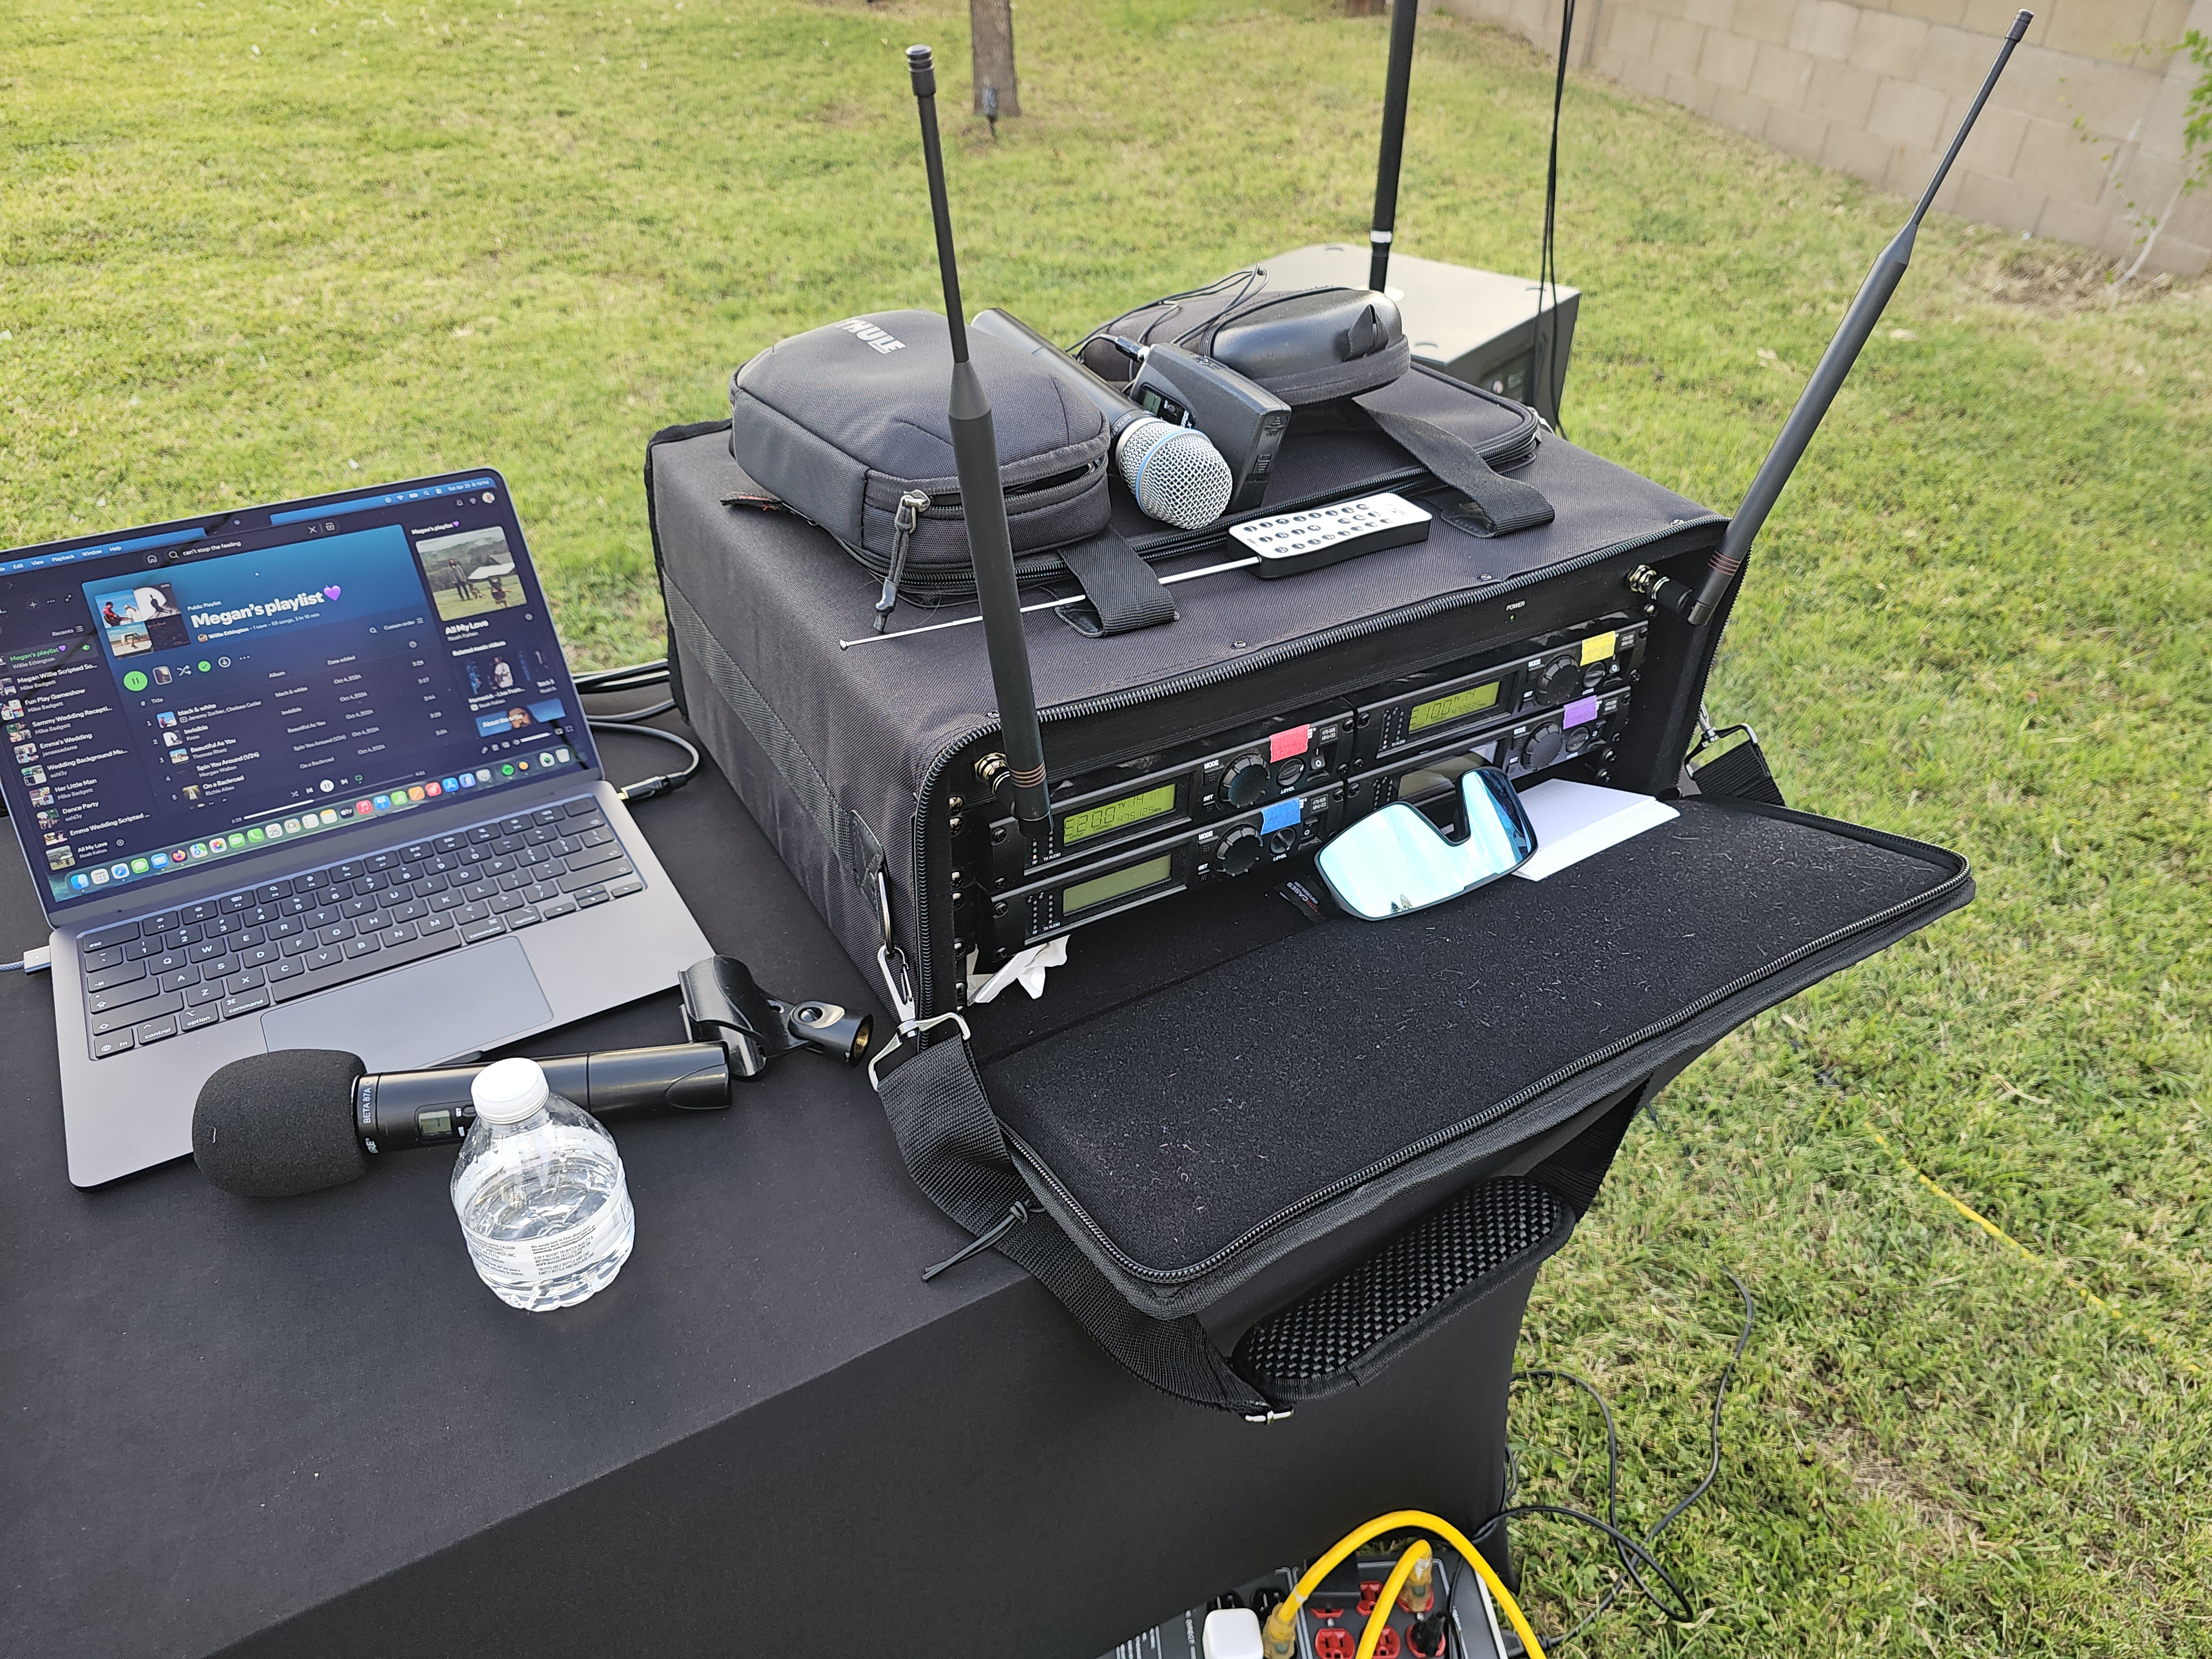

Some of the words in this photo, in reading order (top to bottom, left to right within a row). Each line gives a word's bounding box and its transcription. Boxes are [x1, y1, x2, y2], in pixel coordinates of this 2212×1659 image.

[834, 319, 906, 354] THULE
[221, 541, 242, 550] feeling
[82, 549, 102, 557] Window
[51, 554, 75, 563] Playback
[264, 591, 325, 617] playlist
[1506, 601, 1525, 611] POWER
[445, 626, 457, 635] All
[457, 623, 470, 633] My
[469, 619, 489, 630] Love
[51, 628, 74, 637] Recents
[37, 647, 60, 658] playlist
[29, 656, 56, 667] Ethington
[17, 673, 40, 684] Megan
[39, 671, 58, 680] Willie
[58, 665, 84, 676] Scripted
[34, 680, 56, 688] Badgett
[36, 696, 50, 704] Play
[51, 688, 85, 700] Gameshow
[42, 701, 64, 711] Badgett
[32, 718, 56, 728] Sammy
[56, 712, 84, 723] Wedding
[49, 723, 71, 732] Badgett
[40, 740, 64, 749] Emma's
[64, 733, 93, 744] Wedding
[190, 742, 217, 753] Beautiful
[47, 760, 76, 771] Wedding
[76, 751, 113, 765] Background
[196, 764, 211, 773] Spin
[210, 760, 222, 769] You
[222, 755, 243, 766] Around
[1204, 759, 1219, 769] MODE
[217, 774, 245, 786] Backroad
[1280, 786, 1295, 795] LEVEL
[1203, 794, 1214, 802] SET
[62, 806, 82, 815] Dance
[82, 801, 100, 811] Party
[70, 828, 90, 837] Emma
[89, 820, 118, 832] Wedding
[118, 812, 144, 824] Scripted
[1093, 823, 1113, 832] CHANNEL
[269, 828, 280, 837] 25
[1198, 831, 1214, 841] MODE
[94, 841, 108, 849] Love
[1049, 852, 1061, 860] AUDIO
[1273, 853, 1287, 862] LEVEL
[389, 891, 399, 899] U
[369, 917, 378, 925] H
[429, 919, 441, 927] M
[394, 930, 404, 938] N
[201, 945, 213, 953] W
[357, 941, 366, 950] B
[319, 952, 328, 961] V
[242, 975, 250, 984] X
[201, 988, 210, 997] Z
[228, 999, 264, 1014] command
[187, 1015, 211, 1027] option
[144, 1027, 171, 1040] control
[362, 1087, 372, 1103] 87A
[363, 1102, 371, 1124] BETA
